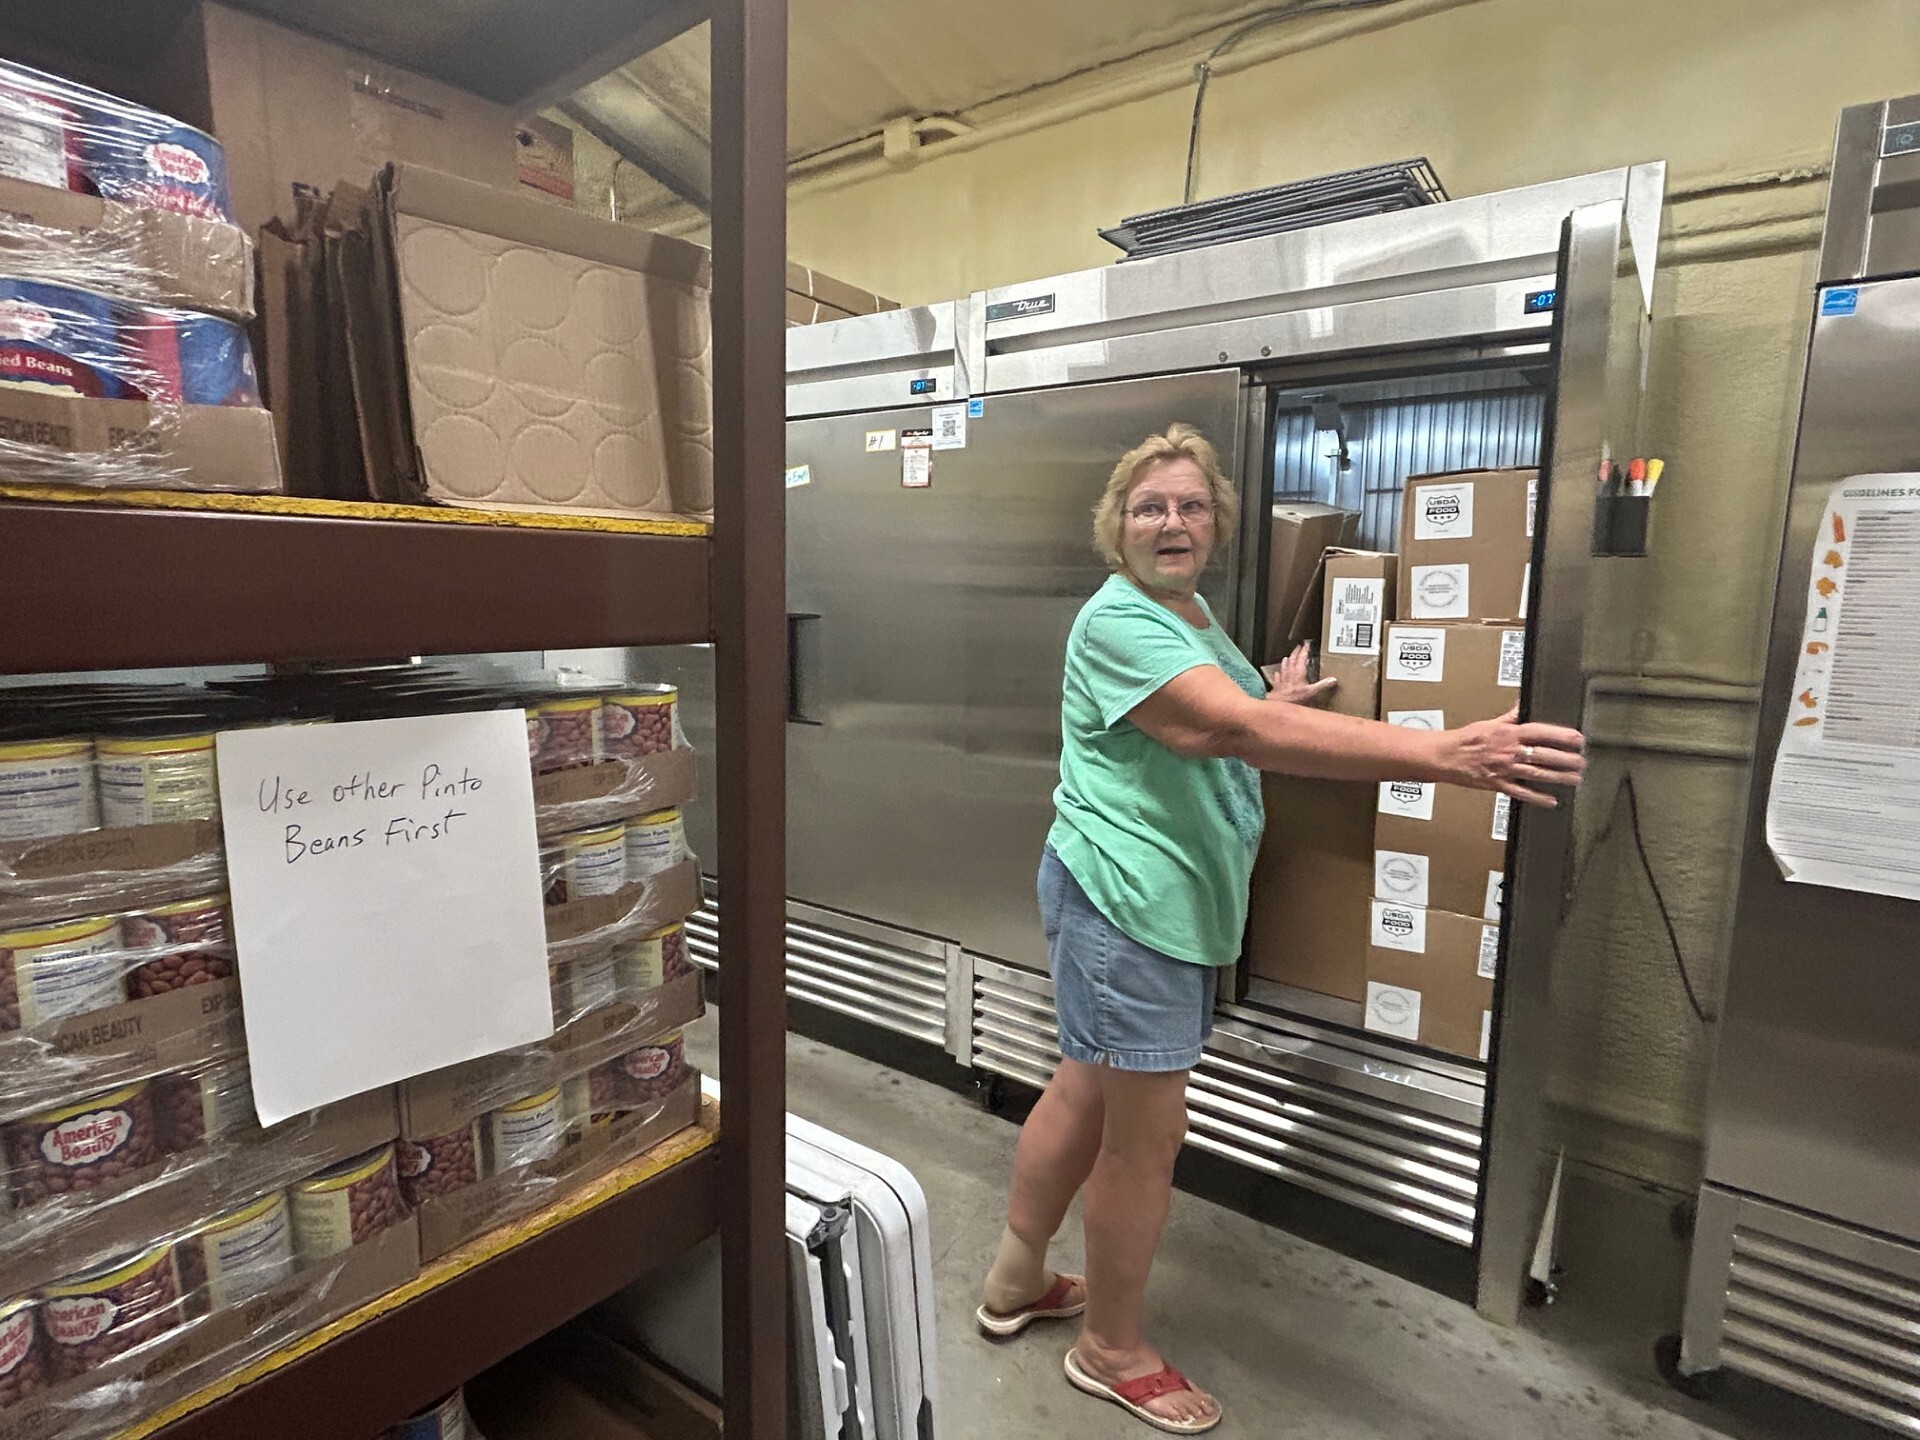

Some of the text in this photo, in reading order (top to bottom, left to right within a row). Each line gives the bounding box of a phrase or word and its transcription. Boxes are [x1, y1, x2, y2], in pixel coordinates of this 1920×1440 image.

[1012, 300, 1050, 311] True
[26, 356, 73, 377] Beans
[259, 764, 484, 813] Use other Pinto
[285, 824, 366, 864] Beans
[1385, 911, 1411, 920] USDA
[92, 1016, 143, 1046] BEAUTY
[52, 1115, 122, 1147] American
[61, 1132, 117, 1162] Beauty
